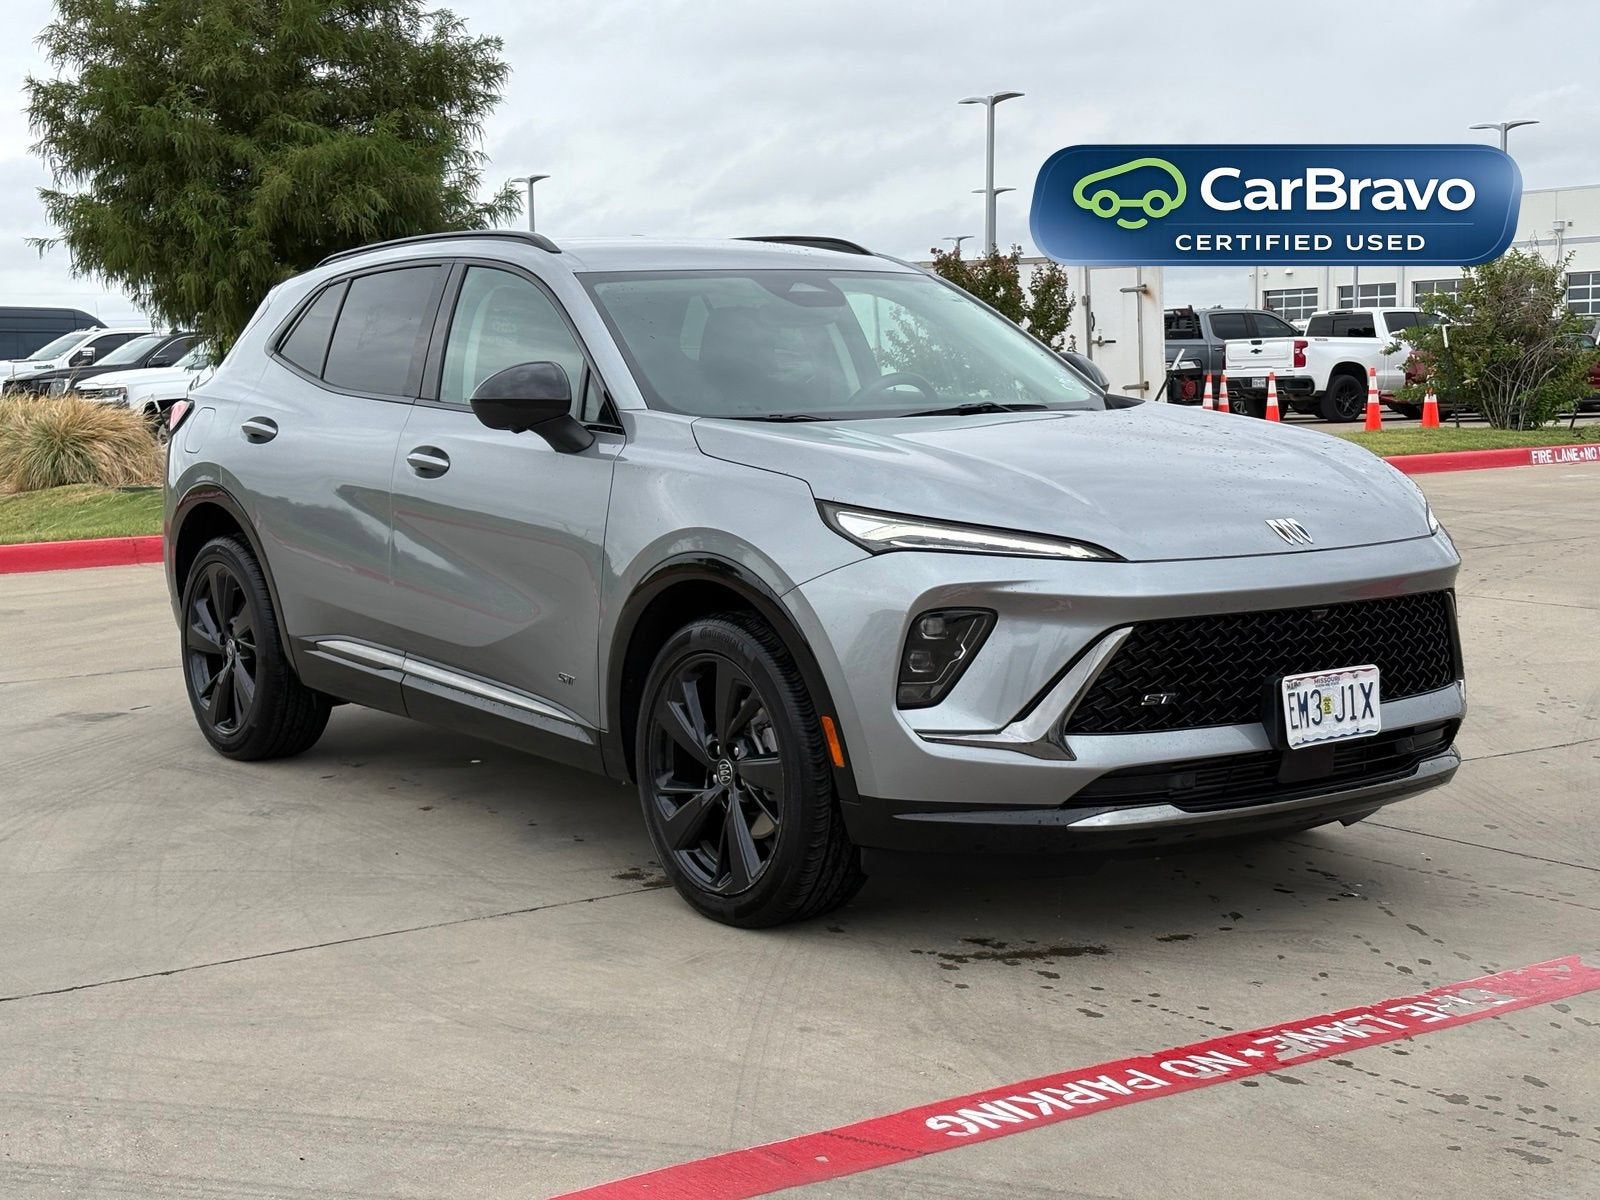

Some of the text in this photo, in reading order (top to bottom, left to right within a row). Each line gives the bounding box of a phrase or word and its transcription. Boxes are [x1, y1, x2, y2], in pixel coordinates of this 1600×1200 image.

[1531, 449, 1554, 464] FIRE
[1554, 447, 1581, 462] LANE
[1583, 446, 1597, 460] NO
[557, 671, 577, 686] ST
[1314, 676, 1341, 684] MISSOURI
[1141, 692, 1176, 706] ST
[1287, 689, 1322, 730] EM3
[1334, 682, 1374, 722] J1X
[1252, 1013, 1409, 1057] LANE
[1159, 1050, 1252, 1079] NO
[925, 1068, 1172, 1137] PARKING
